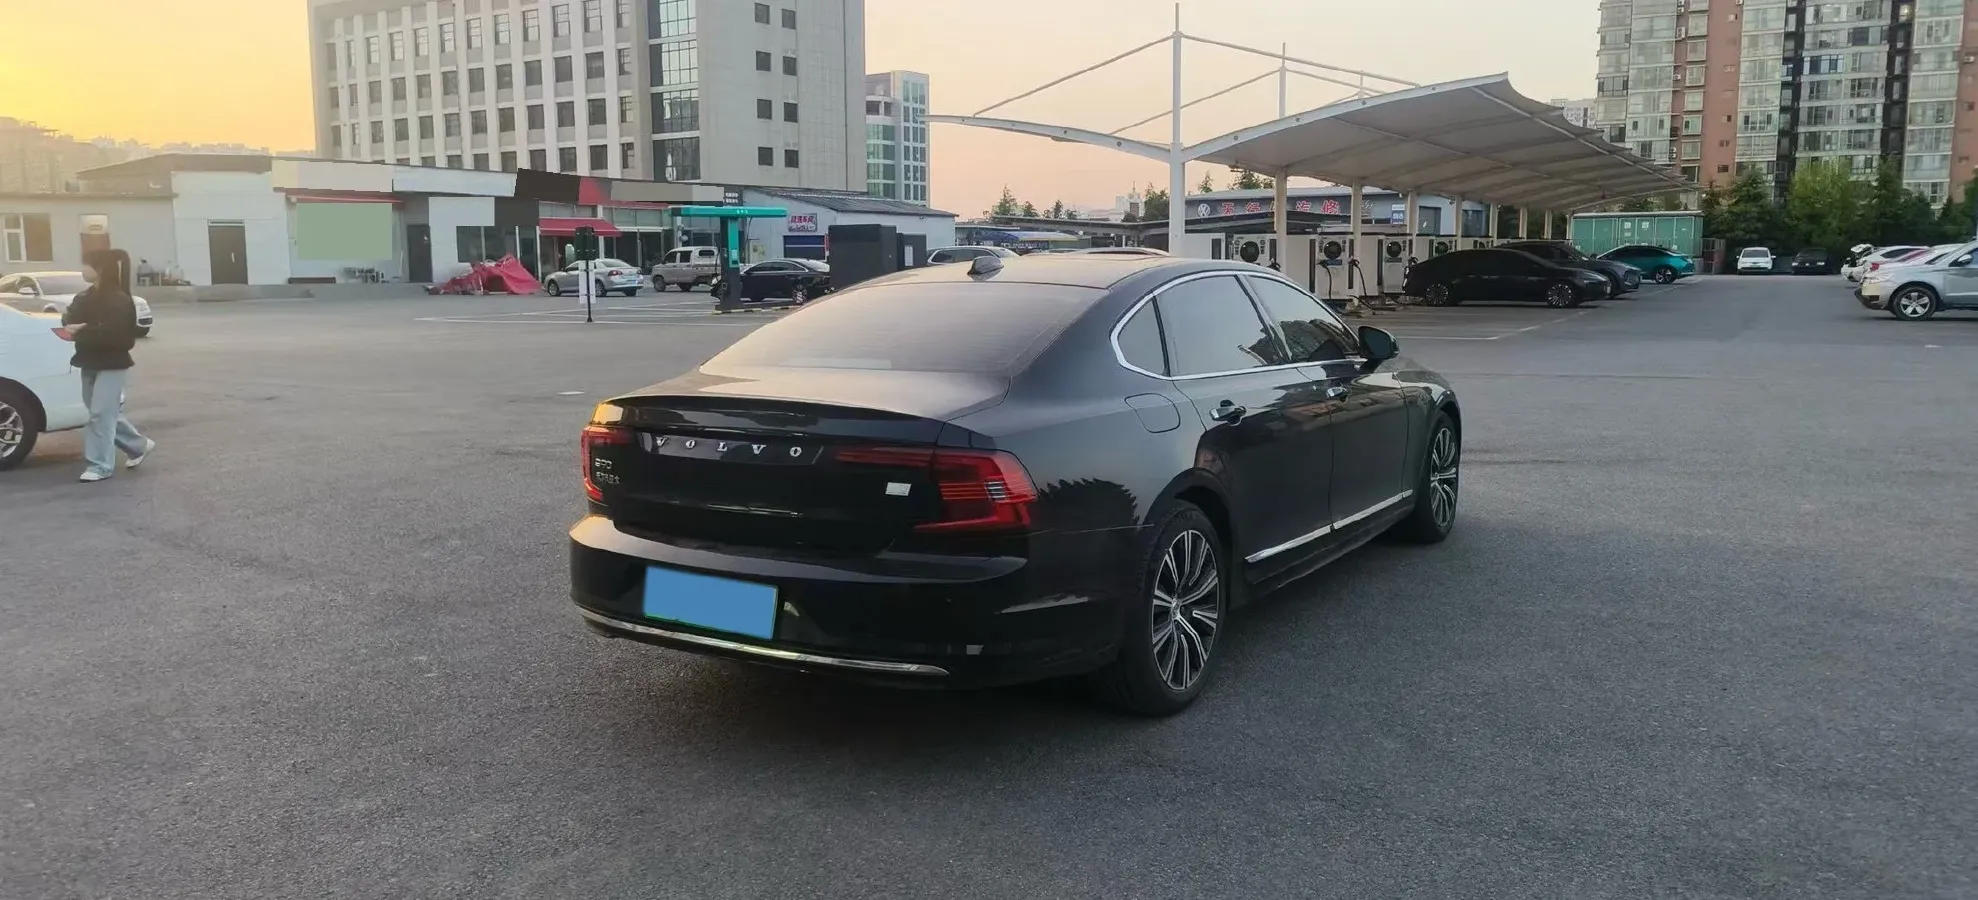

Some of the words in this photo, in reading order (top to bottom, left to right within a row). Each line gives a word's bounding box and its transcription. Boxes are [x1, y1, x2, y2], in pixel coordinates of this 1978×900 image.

[1221, 199, 1341, 216] 天行汽修
[655, 436, 803, 458] VOLVO
